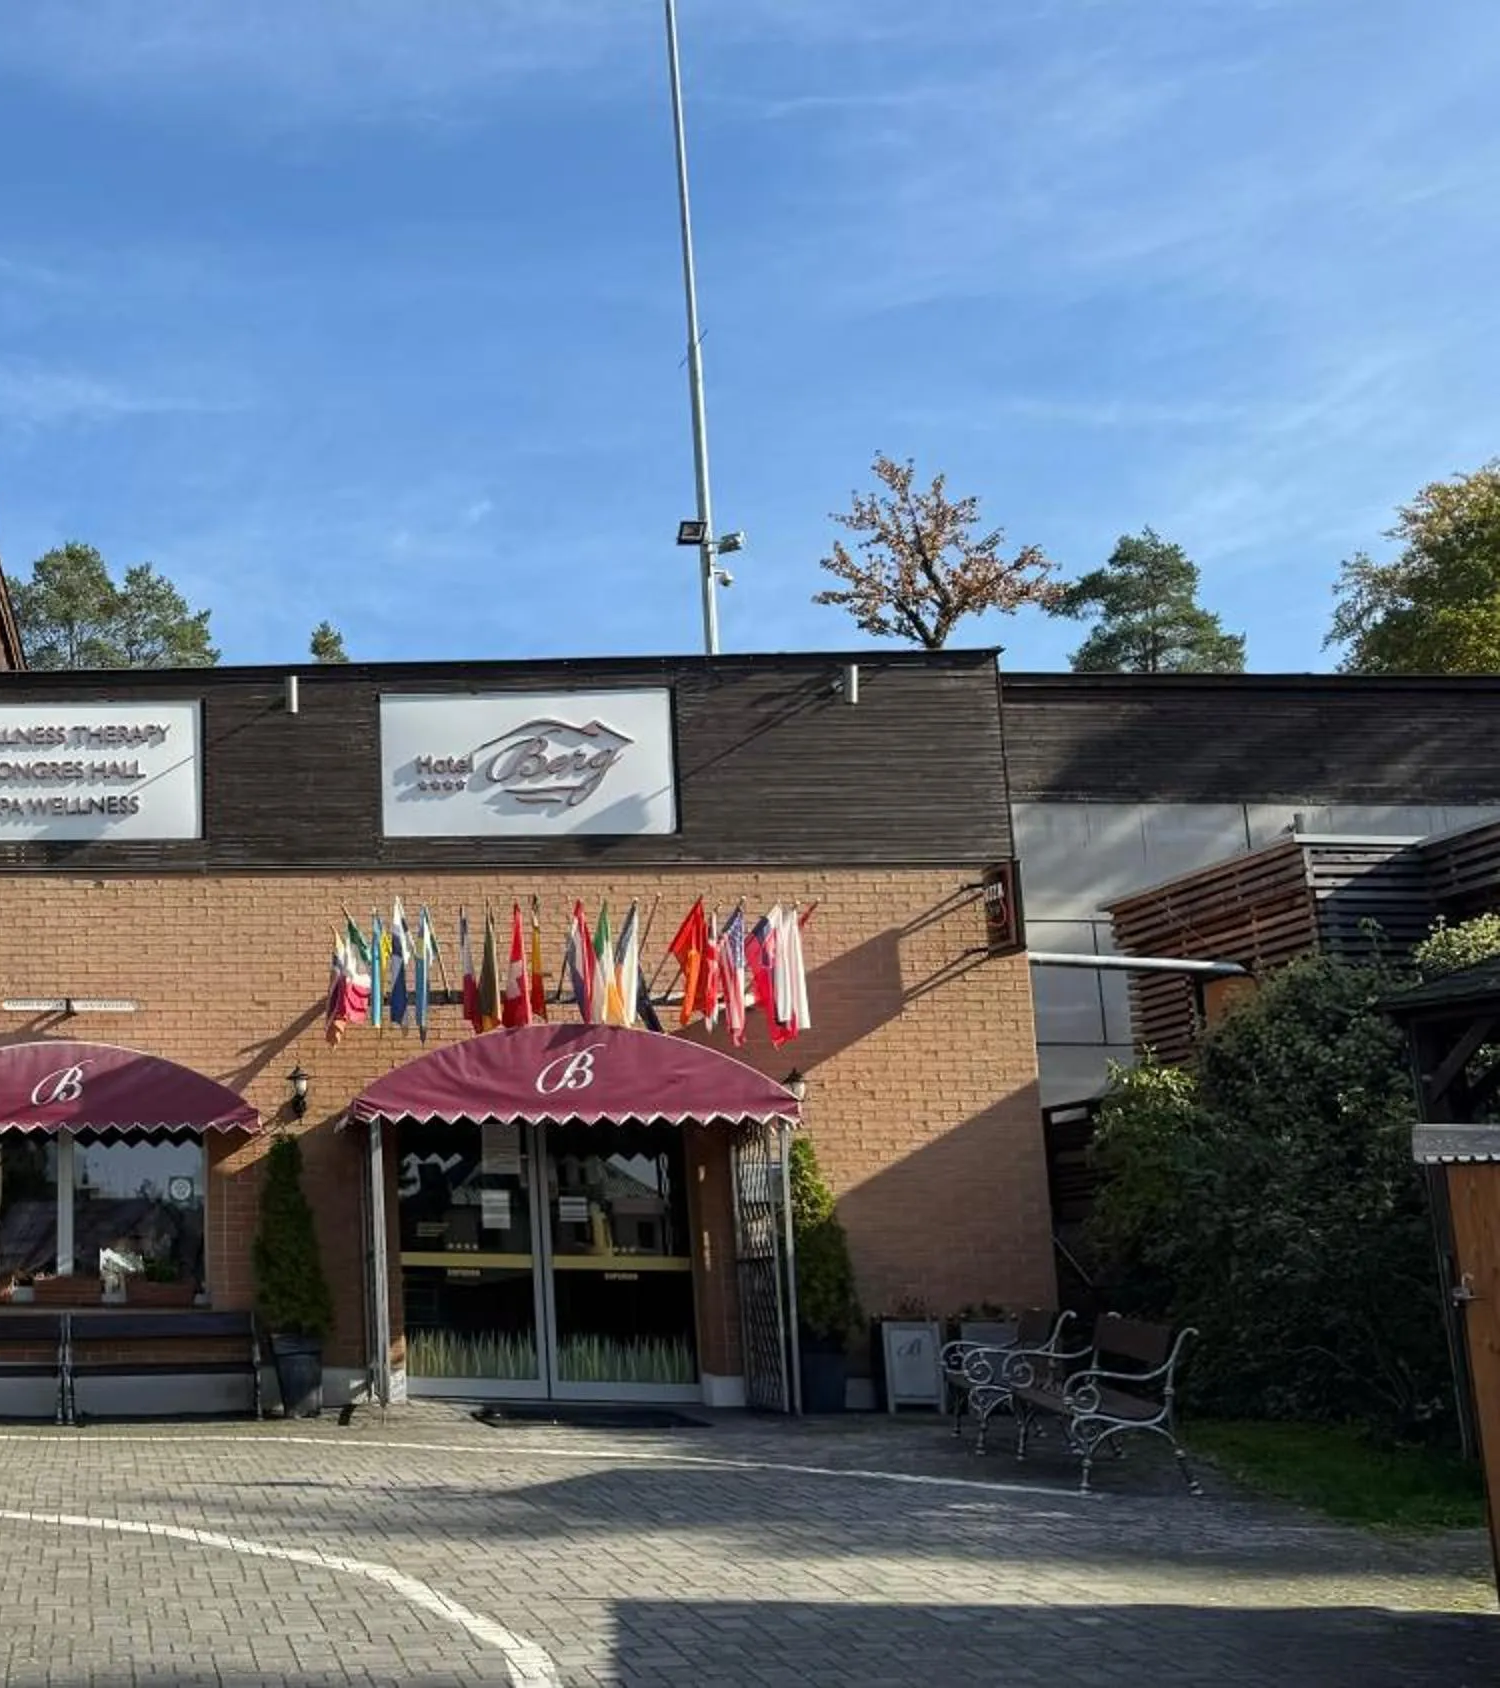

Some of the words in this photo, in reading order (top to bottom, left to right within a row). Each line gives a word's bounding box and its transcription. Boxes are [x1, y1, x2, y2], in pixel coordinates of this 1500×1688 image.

[70, 723, 171, 745] THERAPY
[89, 760, 147, 780] HALL
[415, 752, 474, 777] Hotel
[485, 728, 624, 807] Berg
[26, 795, 141, 816] WELLNESS
[30, 1060, 96, 1106] B
[535, 1043, 607, 1095] B
